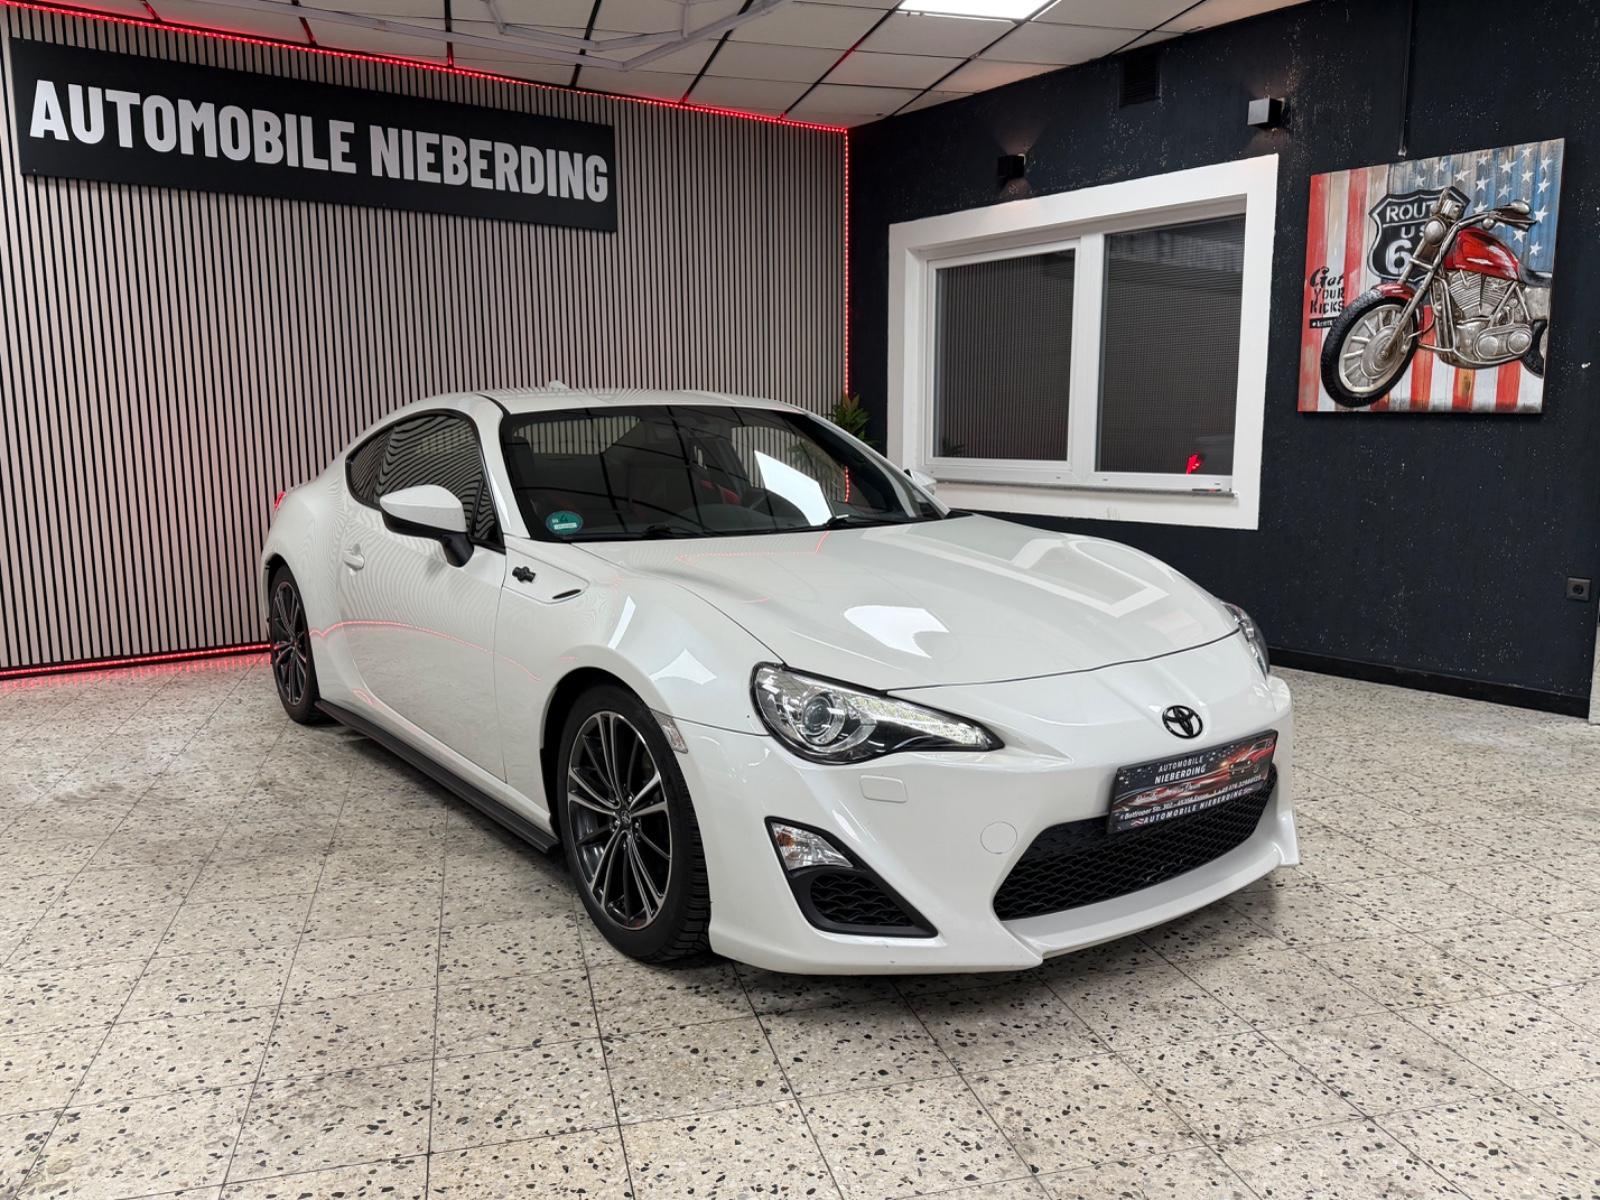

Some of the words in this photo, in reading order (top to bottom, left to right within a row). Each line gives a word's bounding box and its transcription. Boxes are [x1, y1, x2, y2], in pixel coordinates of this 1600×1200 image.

[30, 79, 357, 174] AUTOMOBILE
[370, 125, 610, 203] NIEBERDING
[1386, 200, 1434, 222] ROUT
[1385, 239, 1413, 275] 6
[1313, 287, 1345, 301] YOUR
[1310, 300, 1344, 314] KICKS
[1154, 763, 1207, 785] NIEBERDING
[1158, 756, 1204, 773] AUTOMOBILE
[1143, 805, 1197, 825] AUTOMOBILE
[1199, 790, 1244, 809] NIEBERDING
